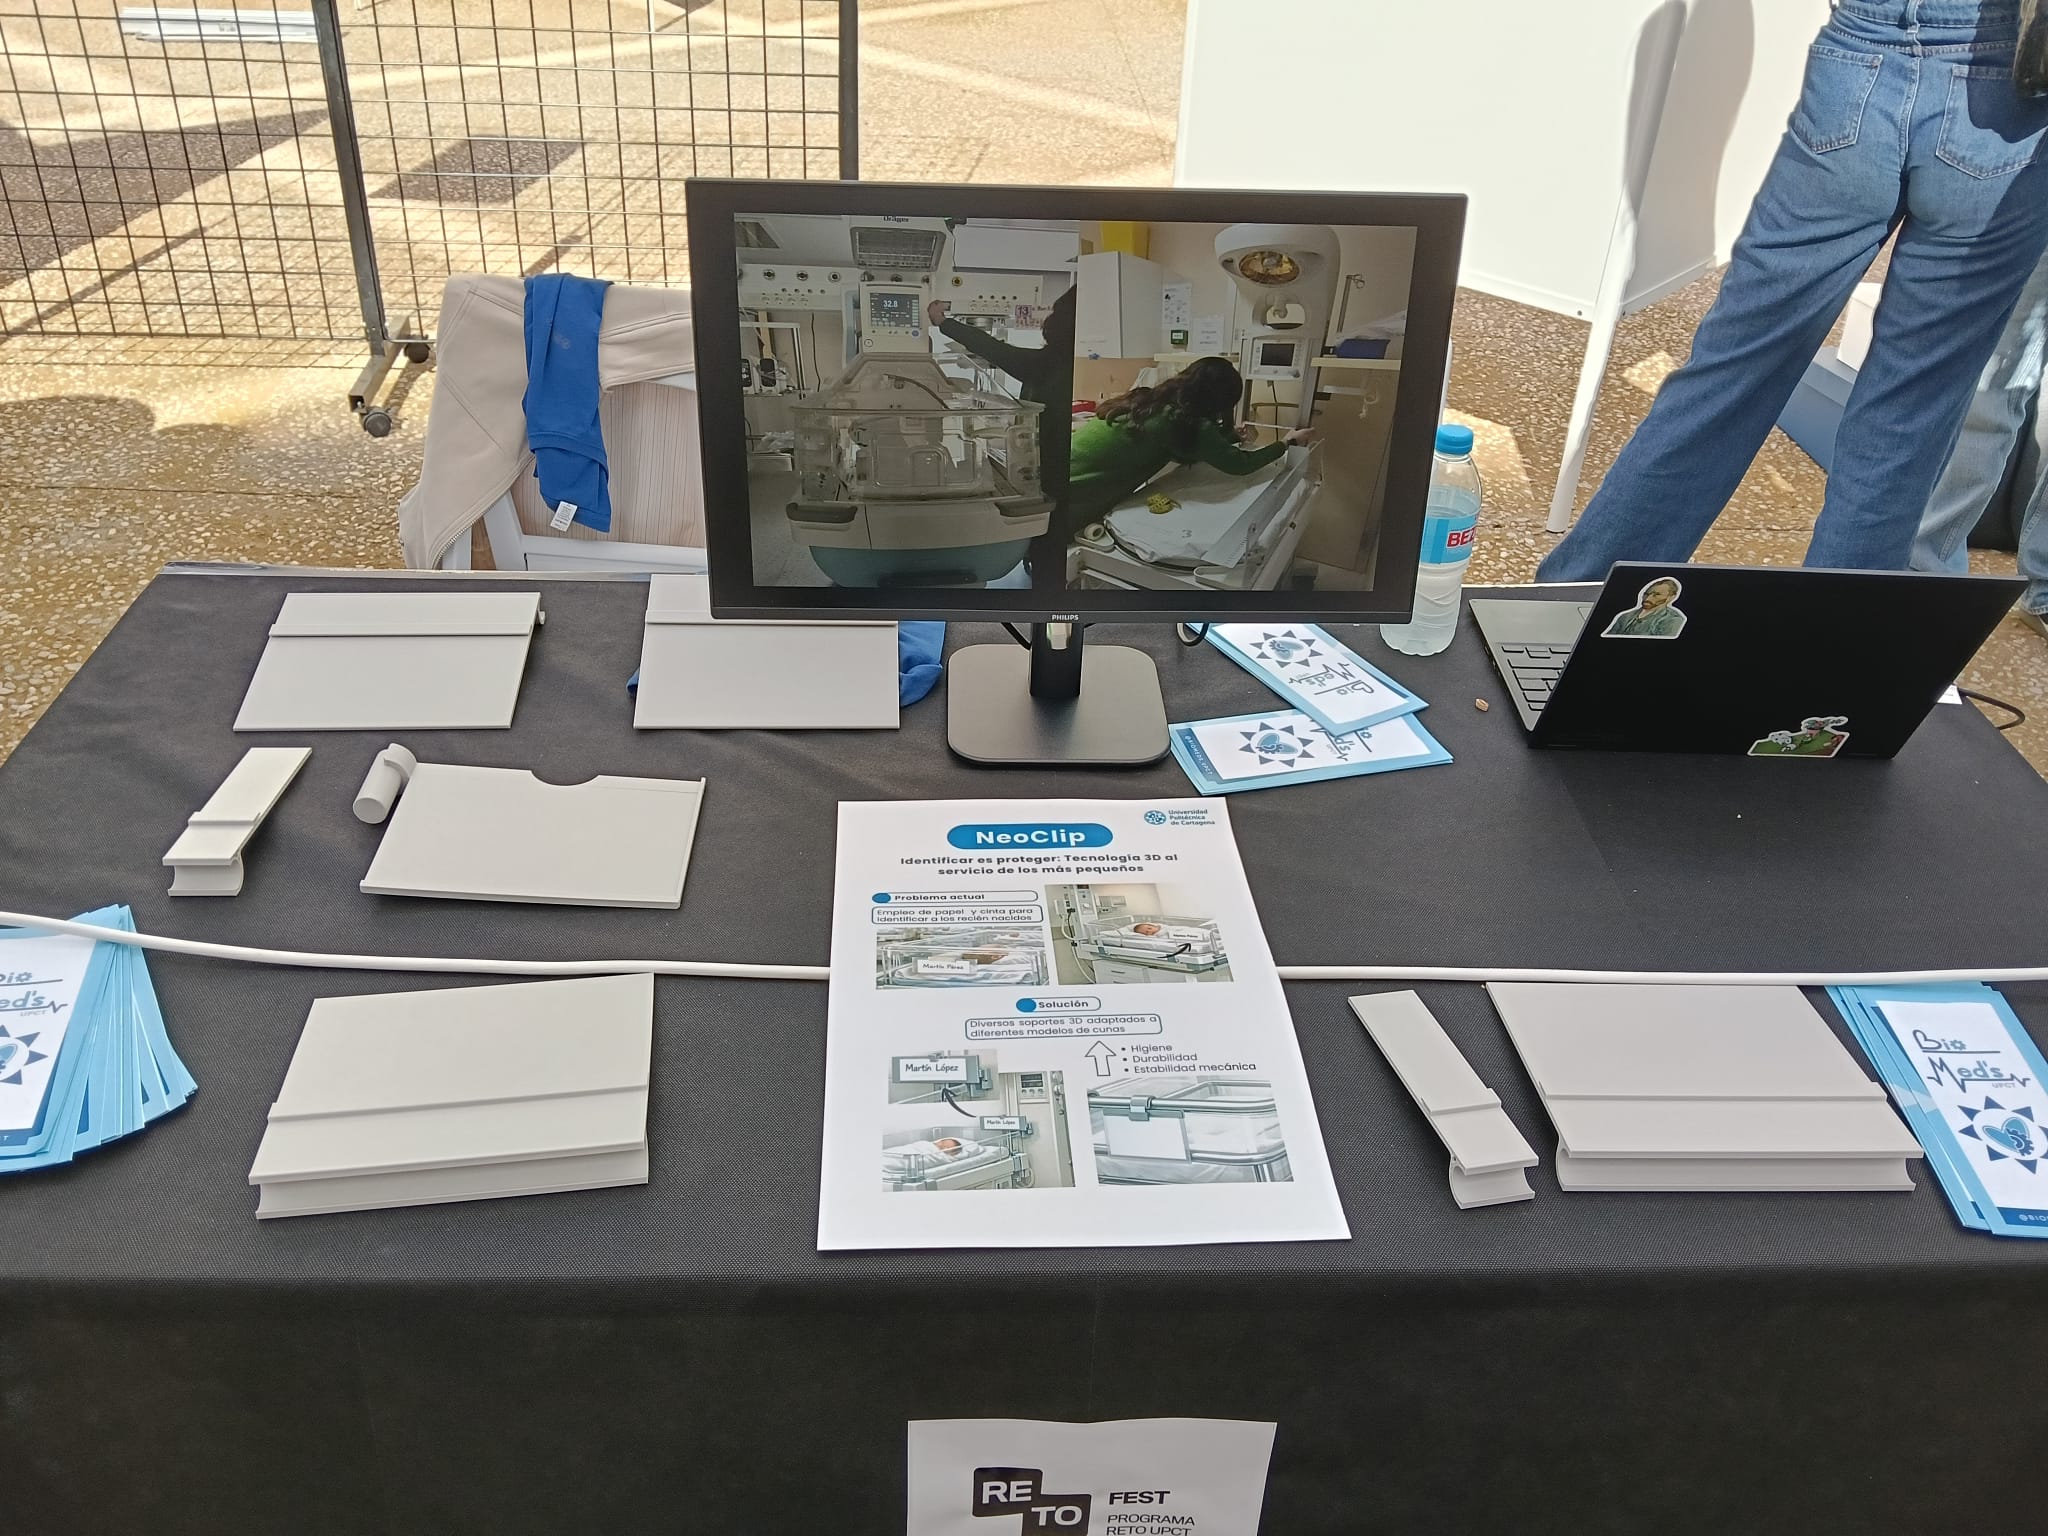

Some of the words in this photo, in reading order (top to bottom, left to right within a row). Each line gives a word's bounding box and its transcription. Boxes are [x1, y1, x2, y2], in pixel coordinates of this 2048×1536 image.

[976, 828, 1086, 847] NeoClip
[900, 856, 974, 865] Identificar
[996, 855, 1061, 865] proteger:
[1064, 853, 1141, 864] Tecnología
[1144, 853, 1162, 861] 3D
[1165, 853, 1178, 861] al
[938, 866, 994, 875] servicio
[997, 866, 1014, 874] de
[1018, 865, 1038, 874] los
[1042, 865, 1072, 873] más
[1076, 864, 1144, 875] pequeños
[894, 893, 947, 901] Problema
[877, 909, 915, 917] Empleo
[918, 908, 932, 916] de
[935, 908, 964, 917] papel
[980, 907, 1006, 915] cinta
[1009, 907, 1033, 916] para
[877, 915, 928, 923] identificar
[957, 914, 989, 922] recién
[1038, 1000, 1089, 1009] Solución
[970, 1020, 1015, 1028] Diversos
[1018, 1018, 1065, 1027] soportes
[1068, 1017, 1083, 1025] 3D
[1086, 1016, 1146, 1025] adaptados
[970, 1029, 1024, 1038] diferentes
[1027, 1027, 1074, 1036] modelos
[1092, 1025, 1126, 1033] cunas
[1911, 1029, 1967, 1051] Bio
[1131, 1045, 1173, 1054] Higiene
[1132, 1053, 1198, 1063] Durabilidad
[905, 1063, 932, 1072] Martín
[935, 1063, 959, 1073] López
[1134, 1063, 1197, 1073] Estabilidad
[1199, 1062, 1257, 1072] mecánica
[981, 1480, 1033, 1505] RE
[1108, 1490, 1171, 1506] FEST
[1031, 1505, 1083, 1527] TO
[1106, 1513, 1196, 1526] PROGRAMA
[1105, 1525, 1147, 1536] RETO
[1150, 1526, 1193, 1536] UPCT
